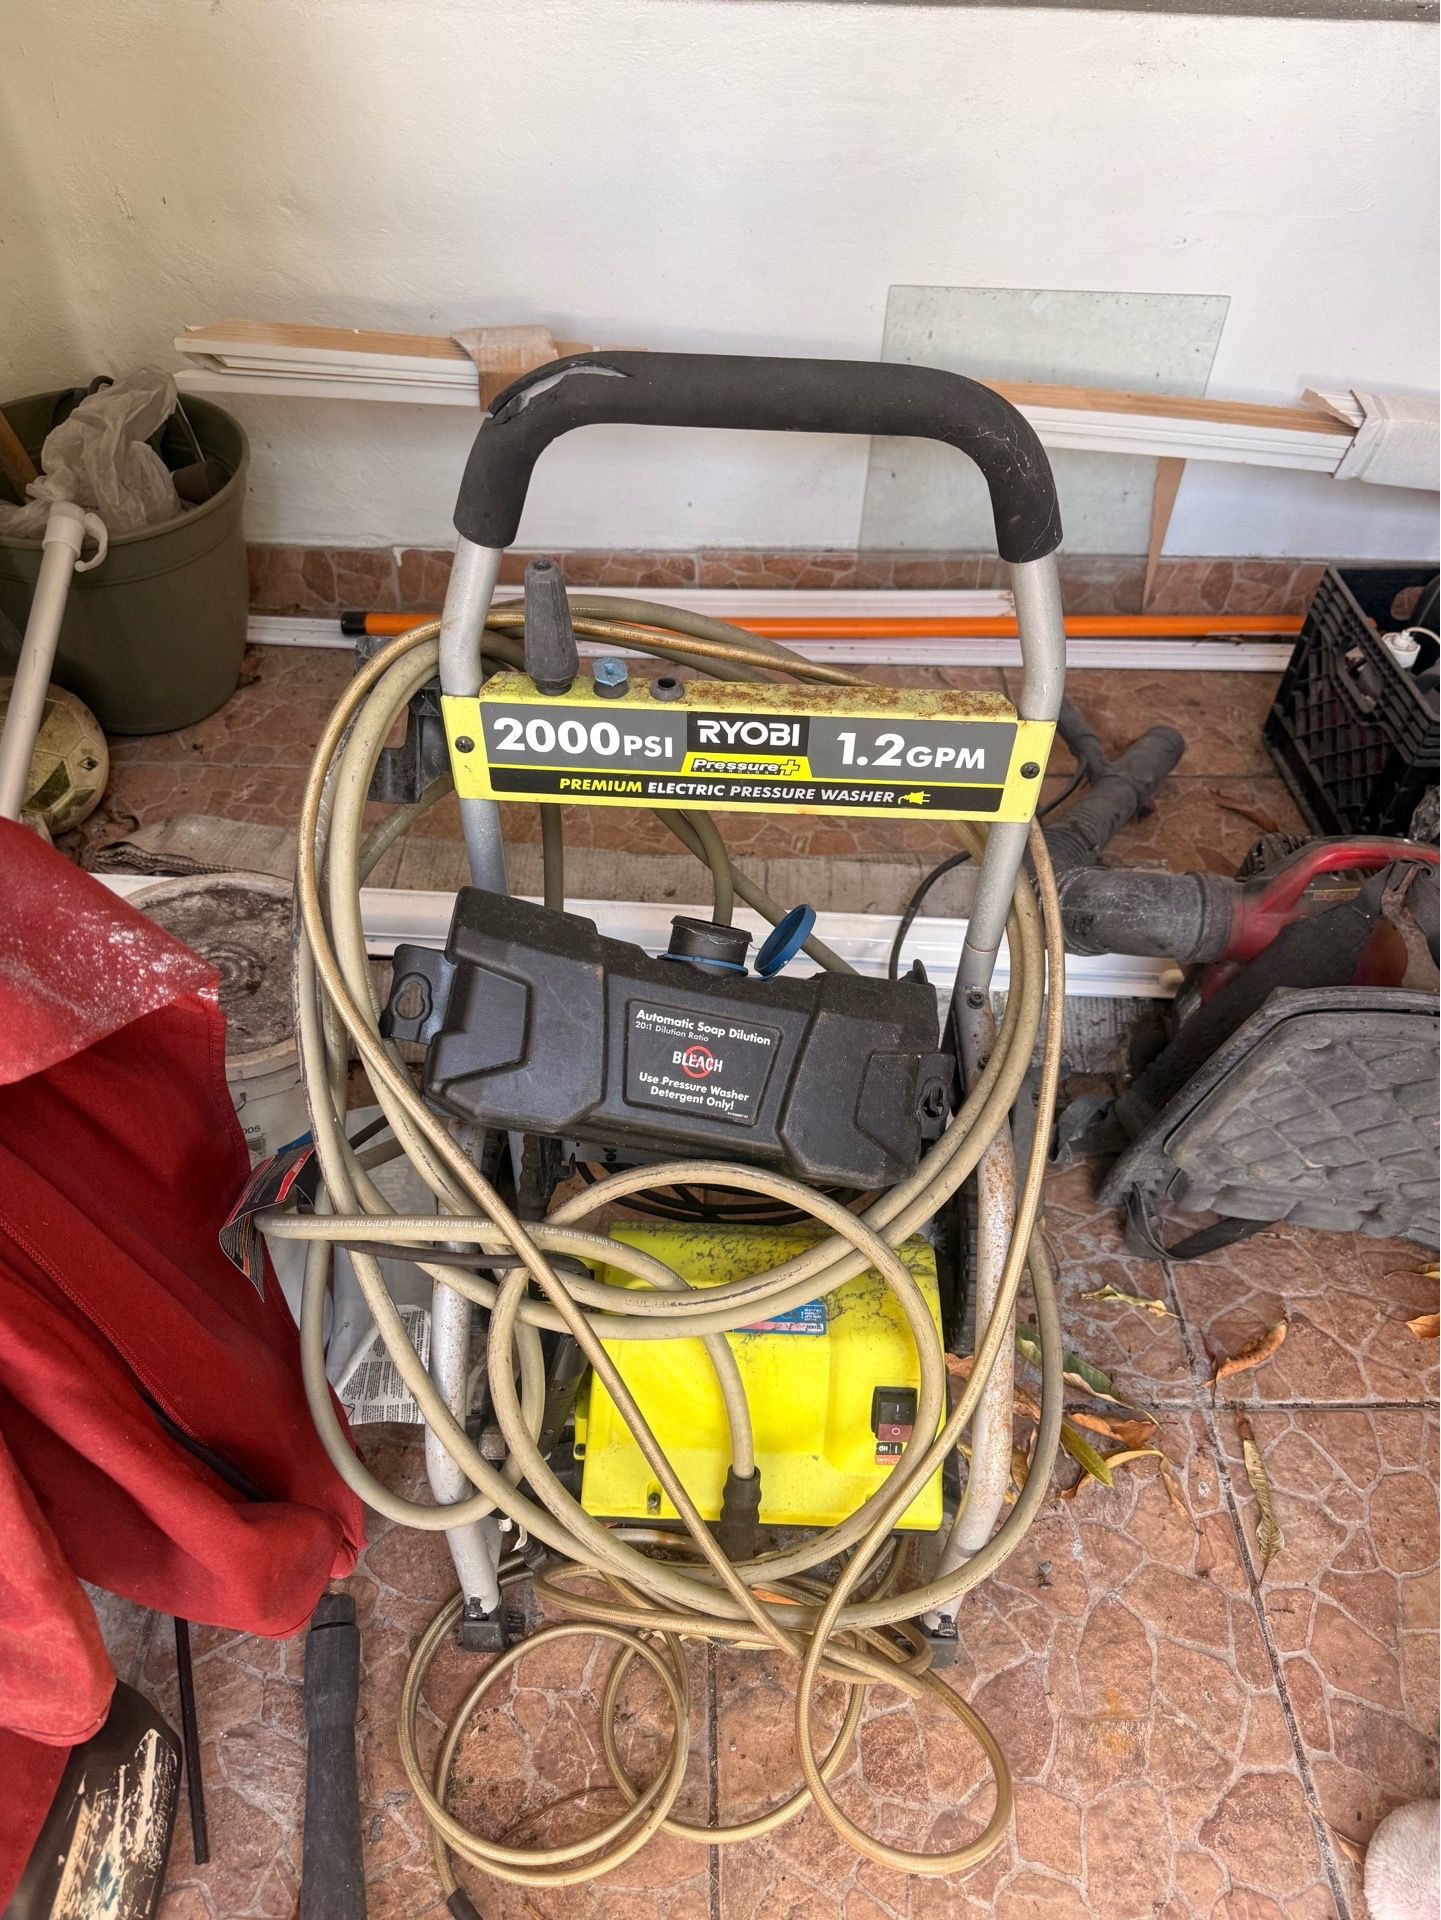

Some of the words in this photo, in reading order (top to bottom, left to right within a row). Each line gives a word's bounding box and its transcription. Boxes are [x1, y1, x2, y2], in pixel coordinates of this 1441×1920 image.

[697, 720, 801, 746] RYOBI
[559, 778, 643, 793] PREMIUM
[647, 782, 725, 797] ELECTRIC
[729, 785, 815, 801] PRESSURE
[820, 789, 895, 804] WASHER
[634, 1020, 653, 1031] 20:1
[655, 1026, 686, 1038] Dilution
[688, 1032, 709, 1042] Ratio
[636, 1009, 694, 1031] Automatic
[697, 1021, 726, 1038] Soap
[728, 1028, 771, 1046] Dilution
[672, 1050, 724, 1073] BLEACH
[639, 1071, 660, 1084] Use
[661, 1076, 708, 1094] Pressure
[710, 1085, 750, 1101] Washer
[650, 1085, 704, 1104] Detergent
[706, 1096, 735, 1111] Only!
